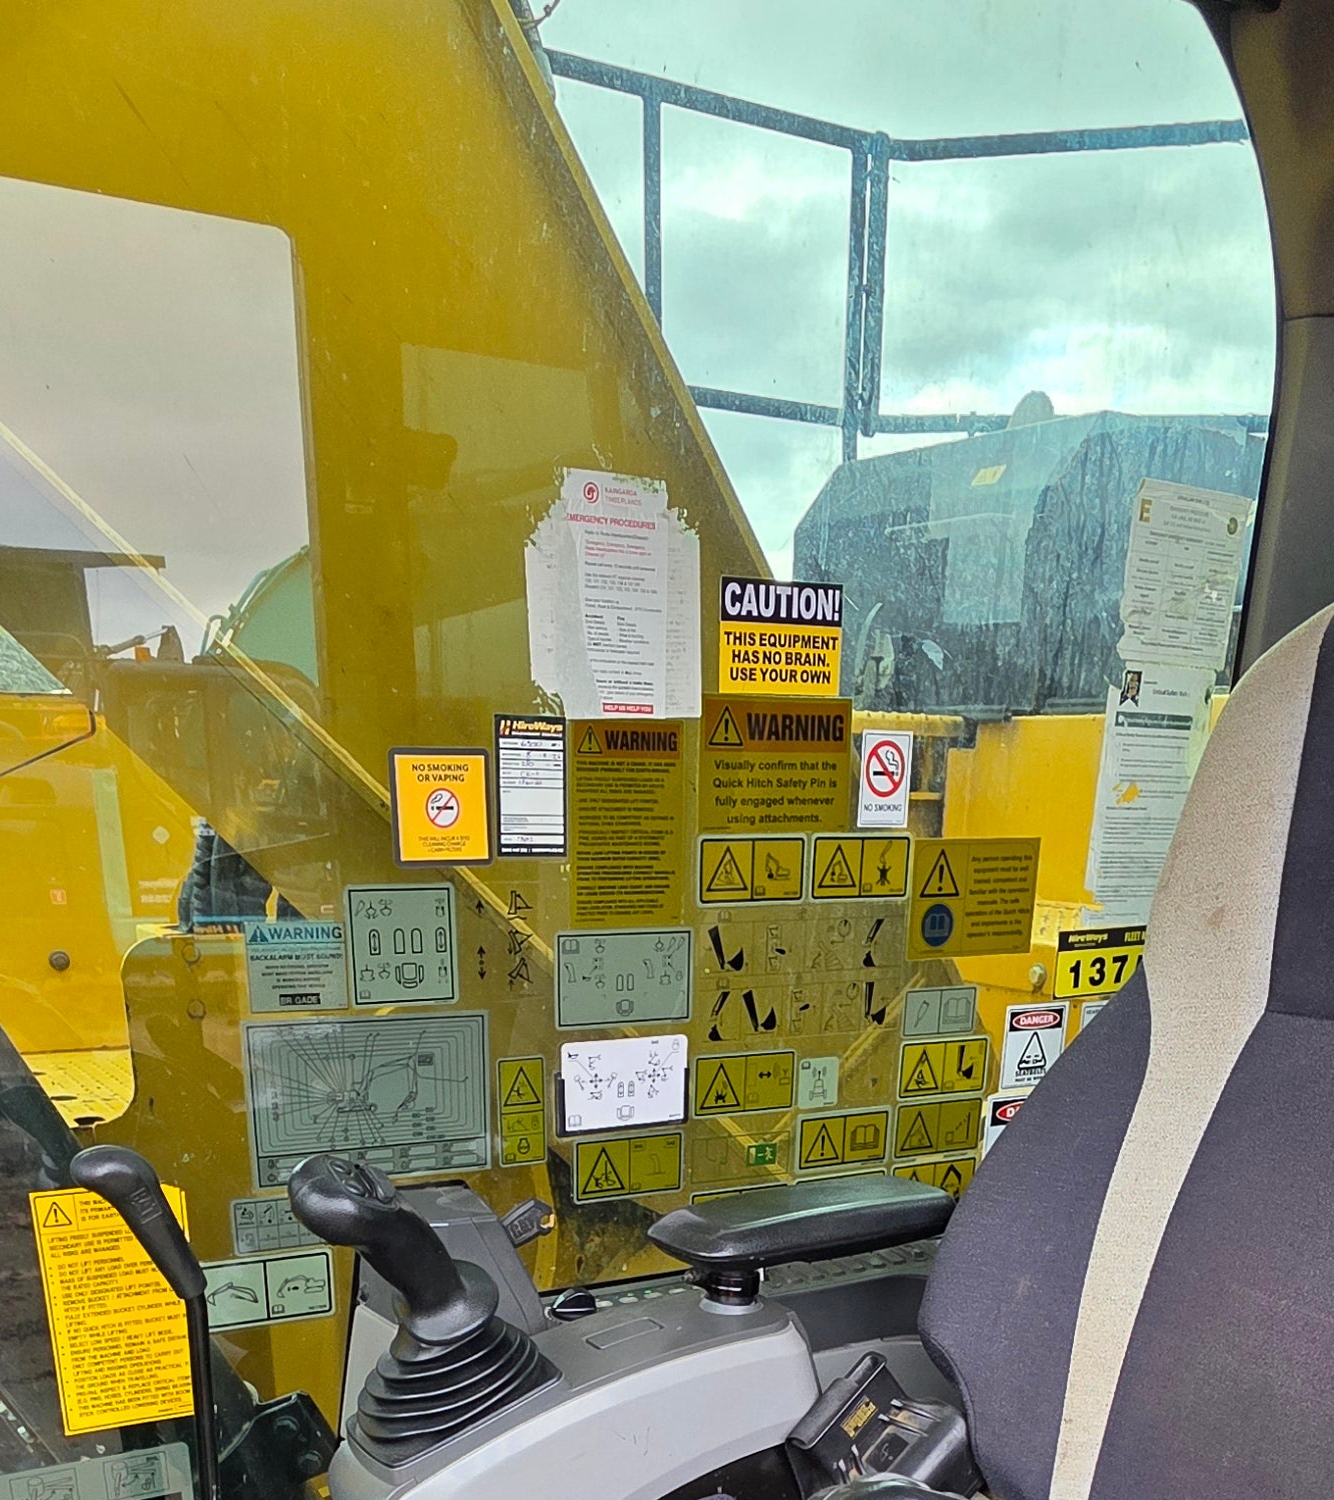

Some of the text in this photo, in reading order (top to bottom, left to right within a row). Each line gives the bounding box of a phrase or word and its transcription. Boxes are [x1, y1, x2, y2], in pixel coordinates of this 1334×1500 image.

[610, 517, 656, 530] PROCEDURES
[724, 582, 841, 622] CAUTION!
[724, 631, 839, 651] THIS EQUIPMENT
[732, 649, 830, 667] HAS NO BRAIN.
[730, 667, 831, 684] USE YOUR OWN
[512, 720, 563, 734] HireWays
[746, 712, 844, 742] WARNING
[605, 730, 678, 752] WARNING
[412, 764, 469, 772] NO SMOKING
[714, 760, 837, 774] Visually confirm that the
[417, 774, 465, 782] OR VAPING
[712, 777, 837, 790] Quick Hitch Safety Pin is
[715, 795, 835, 808] fully engaged whenever
[864, 804, 902, 812] NO SMOKING
[727, 813, 822, 825] using attachments.
[268, 926, 342, 940] WARNING
[1069, 954, 1143, 989] 137
[1019, 1014, 1054, 1025] DANGER
